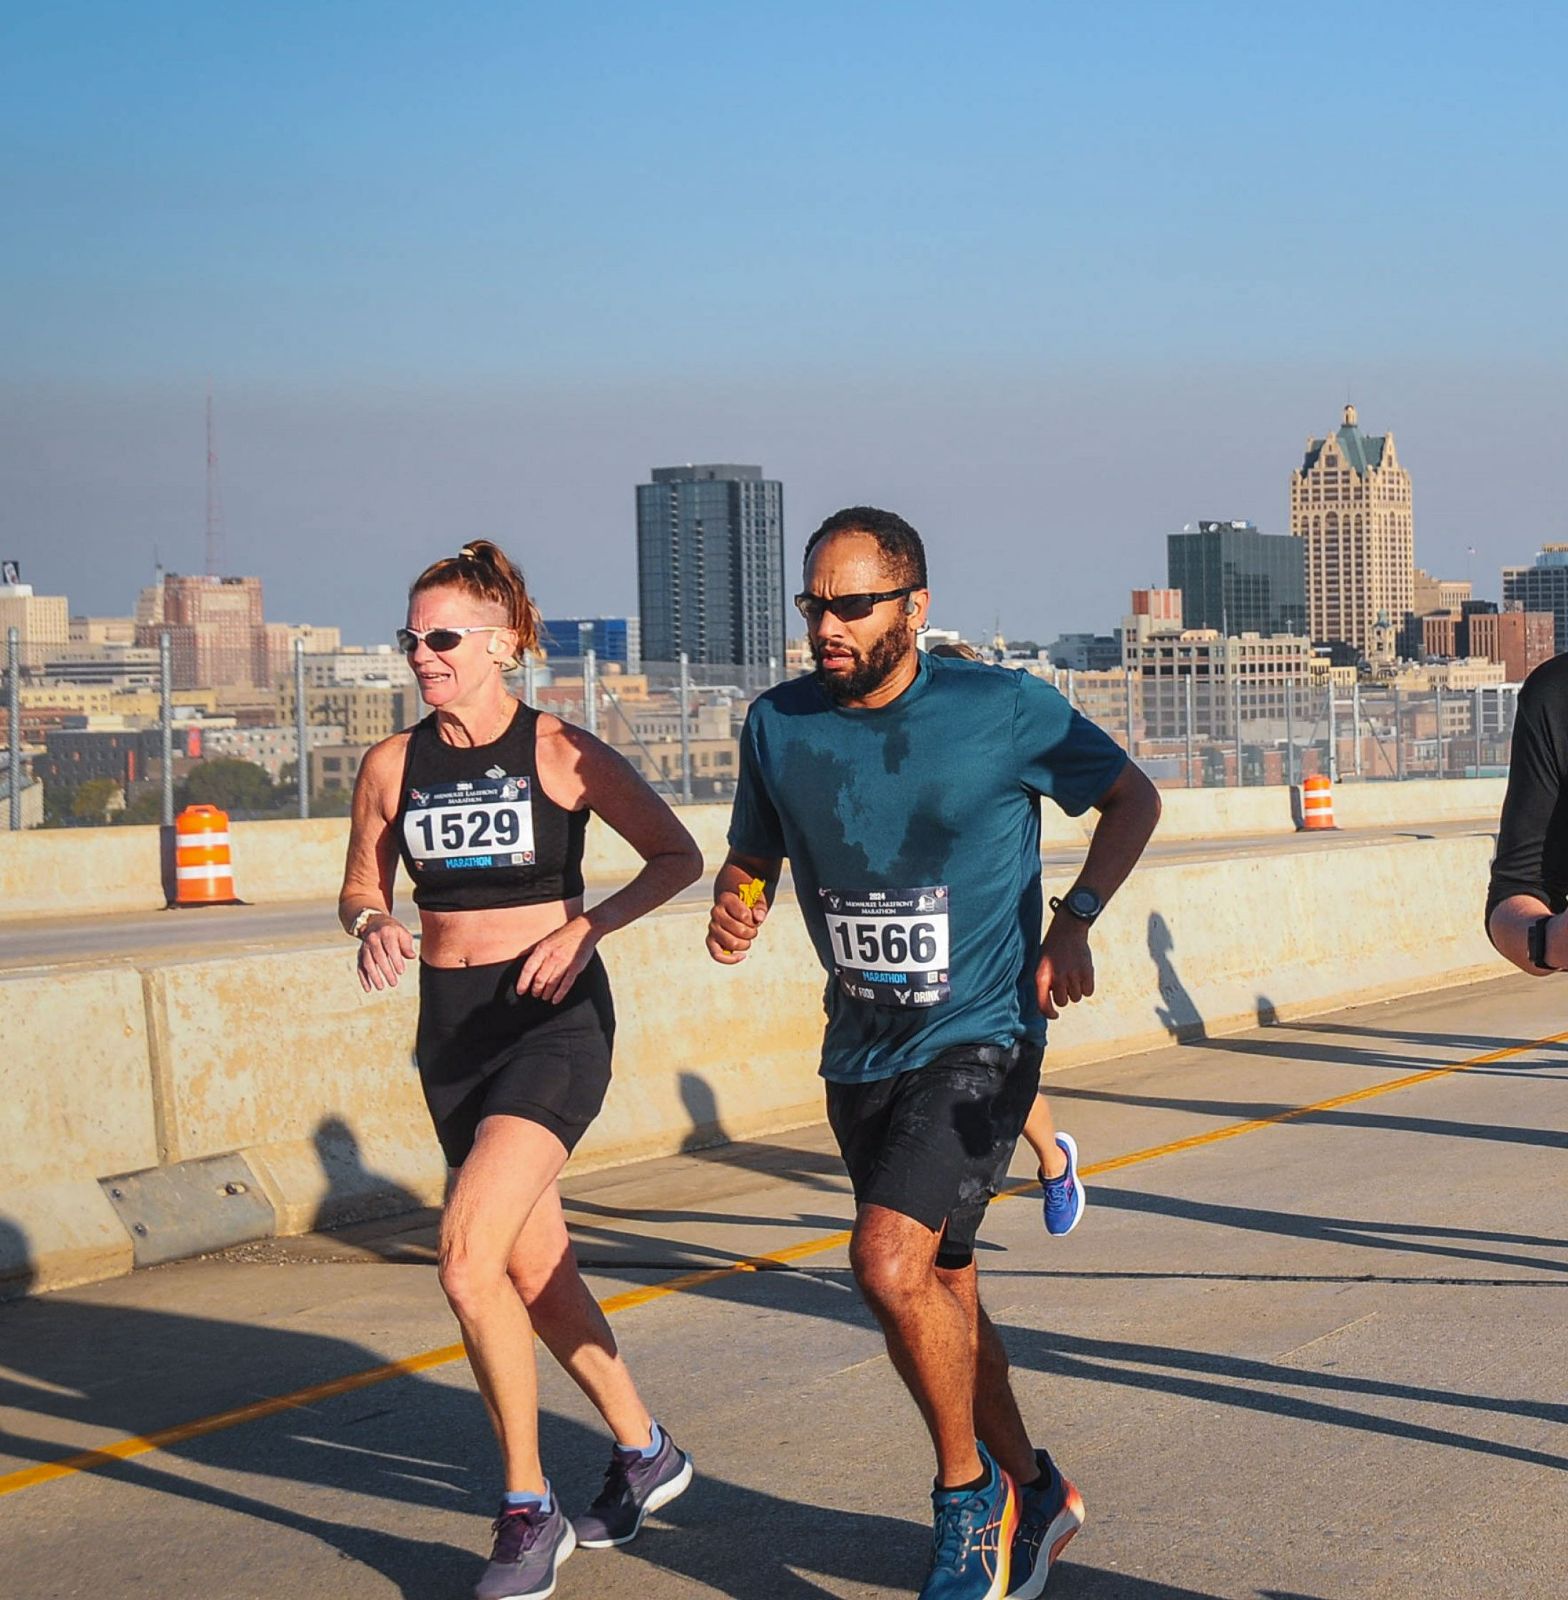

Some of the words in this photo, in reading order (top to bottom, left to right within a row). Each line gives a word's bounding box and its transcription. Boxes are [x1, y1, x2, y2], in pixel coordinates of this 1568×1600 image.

[416, 809, 520, 851] 1529
[446, 856, 492, 869] MARATHON
[835, 922, 937, 964] 1566
[862, 971, 907, 984] MARATHON
[858, 987, 875, 999] FOOD
[913, 990, 940, 1003] DRINK
